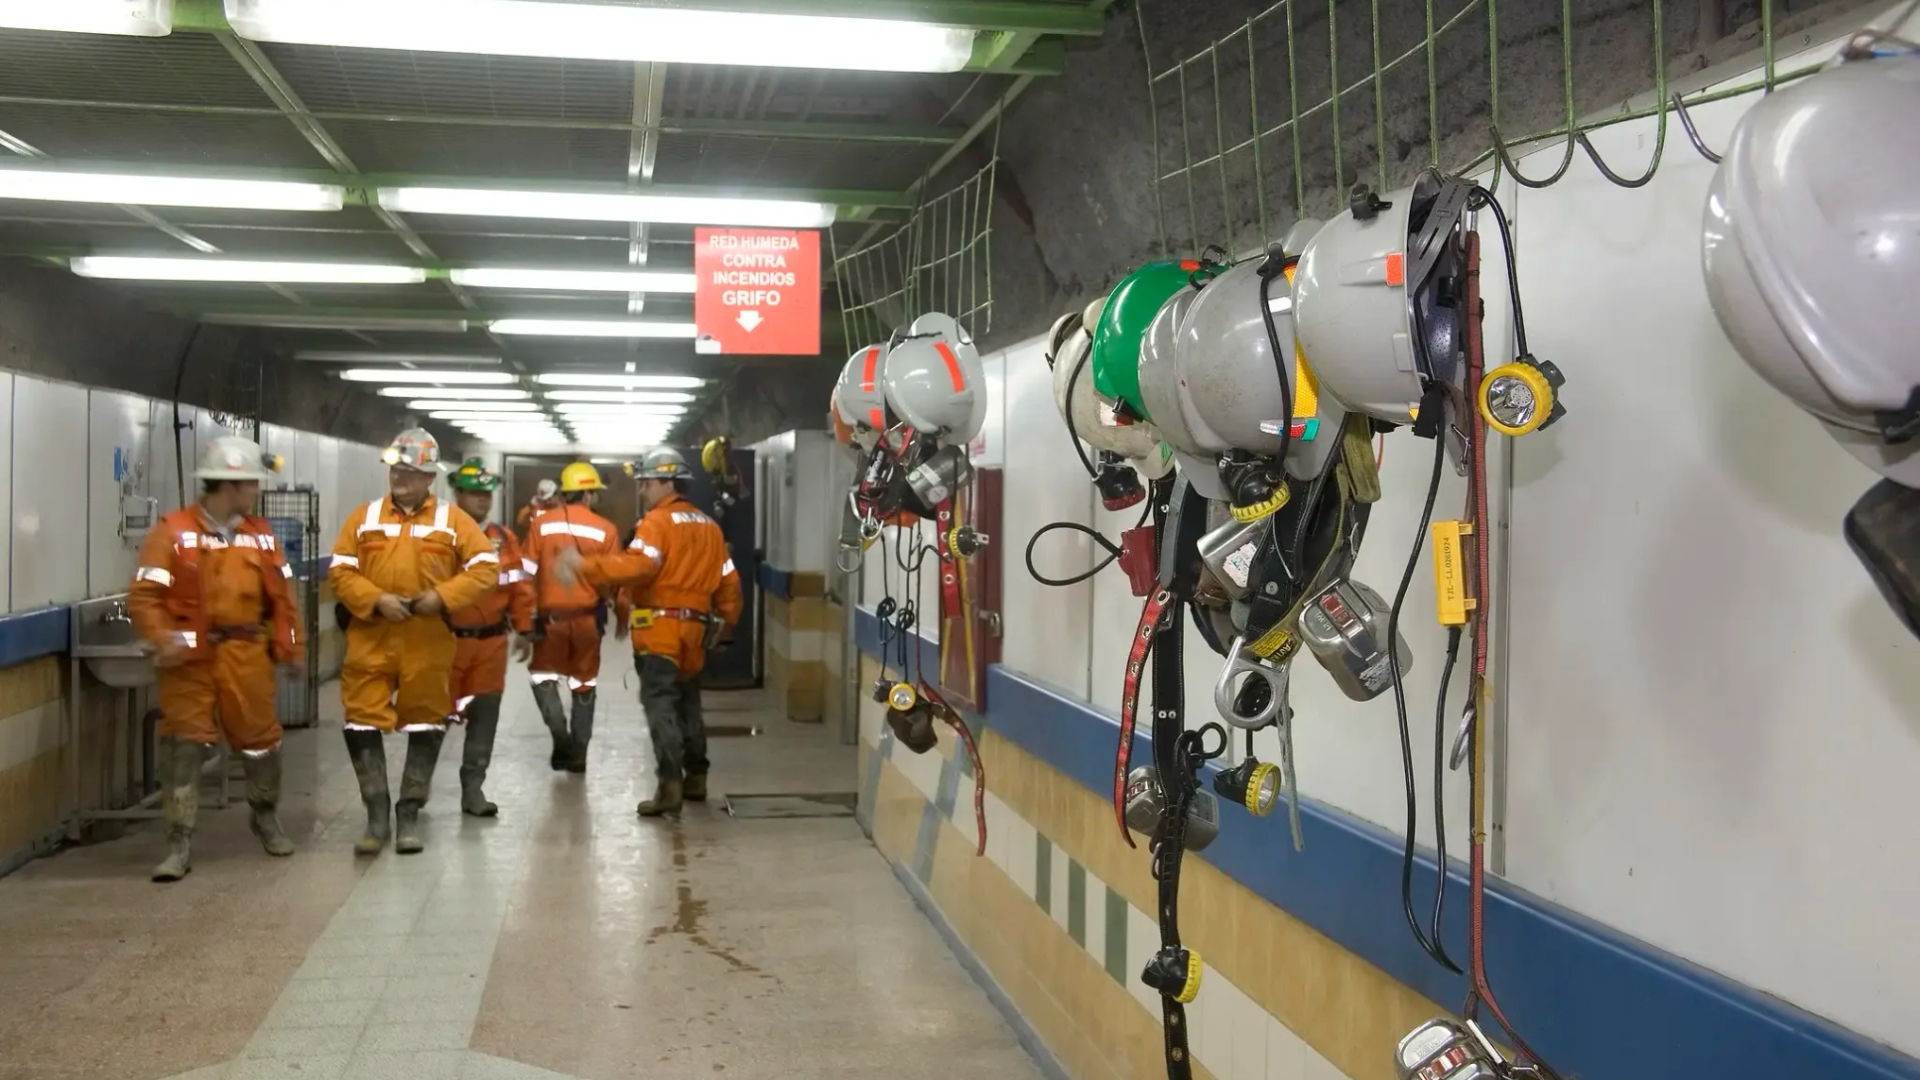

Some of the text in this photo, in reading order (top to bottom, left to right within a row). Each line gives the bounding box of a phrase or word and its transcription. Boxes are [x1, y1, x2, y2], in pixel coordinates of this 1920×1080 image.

[709, 235, 799, 250] RED HUMEDA
[722, 254, 787, 268] CONTRA
[713, 271, 796, 286] INCENDIOS
[722, 290, 781, 306] GRIFO
